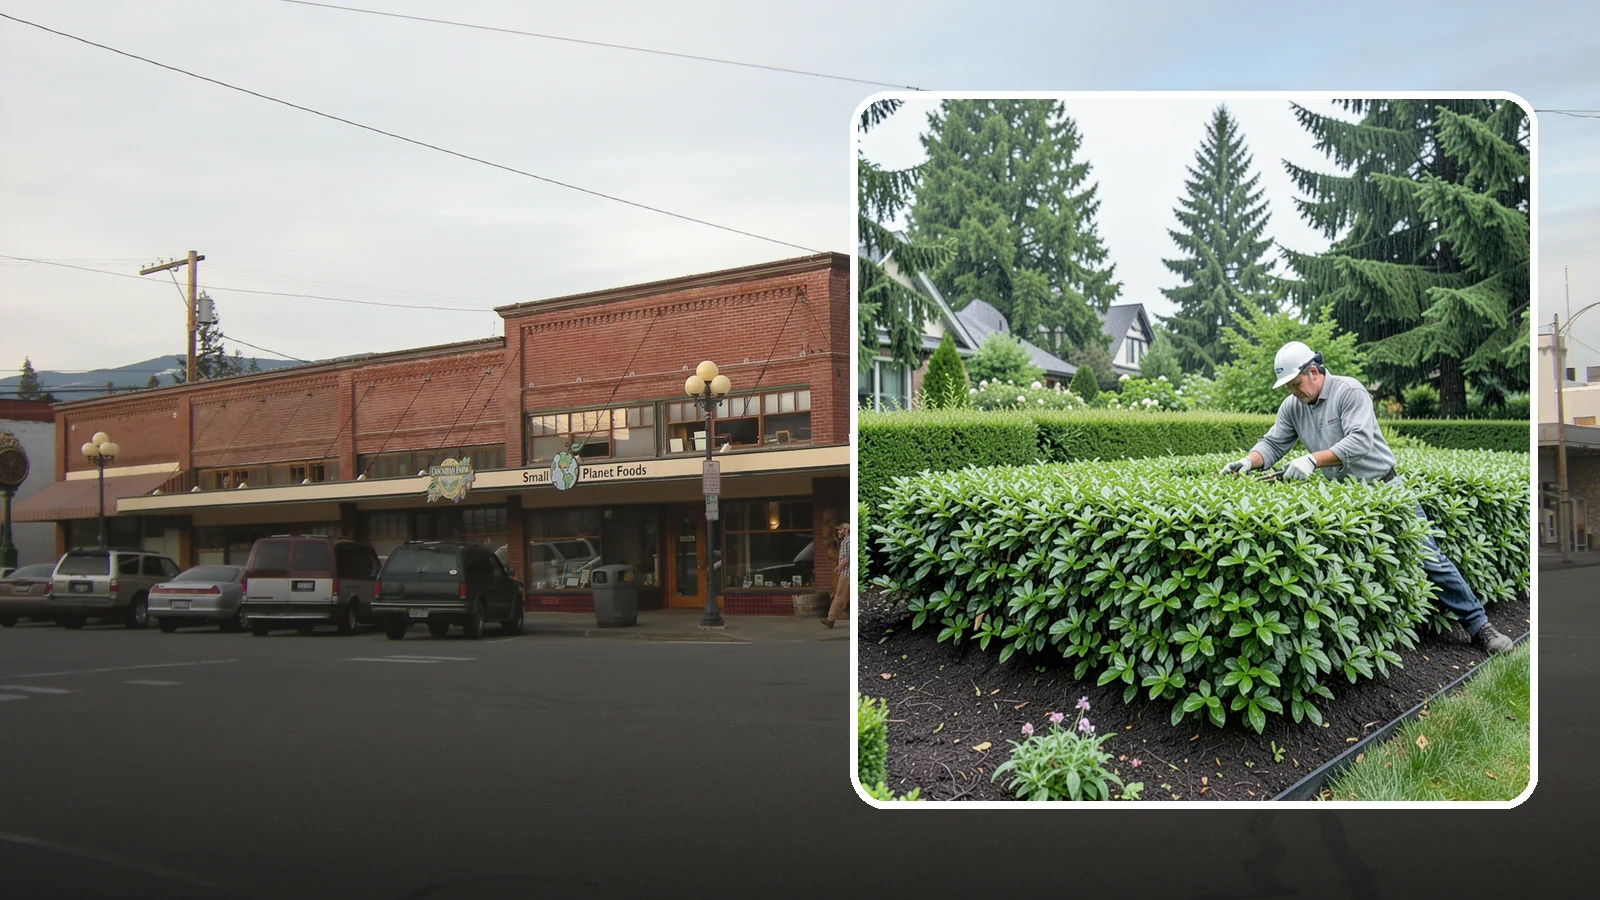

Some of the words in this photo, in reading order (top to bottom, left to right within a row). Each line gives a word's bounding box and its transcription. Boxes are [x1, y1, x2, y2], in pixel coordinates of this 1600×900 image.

[523, 471, 549, 483] Small
[583, 467, 614, 479] Planet
[617, 464, 647, 477] Foods
